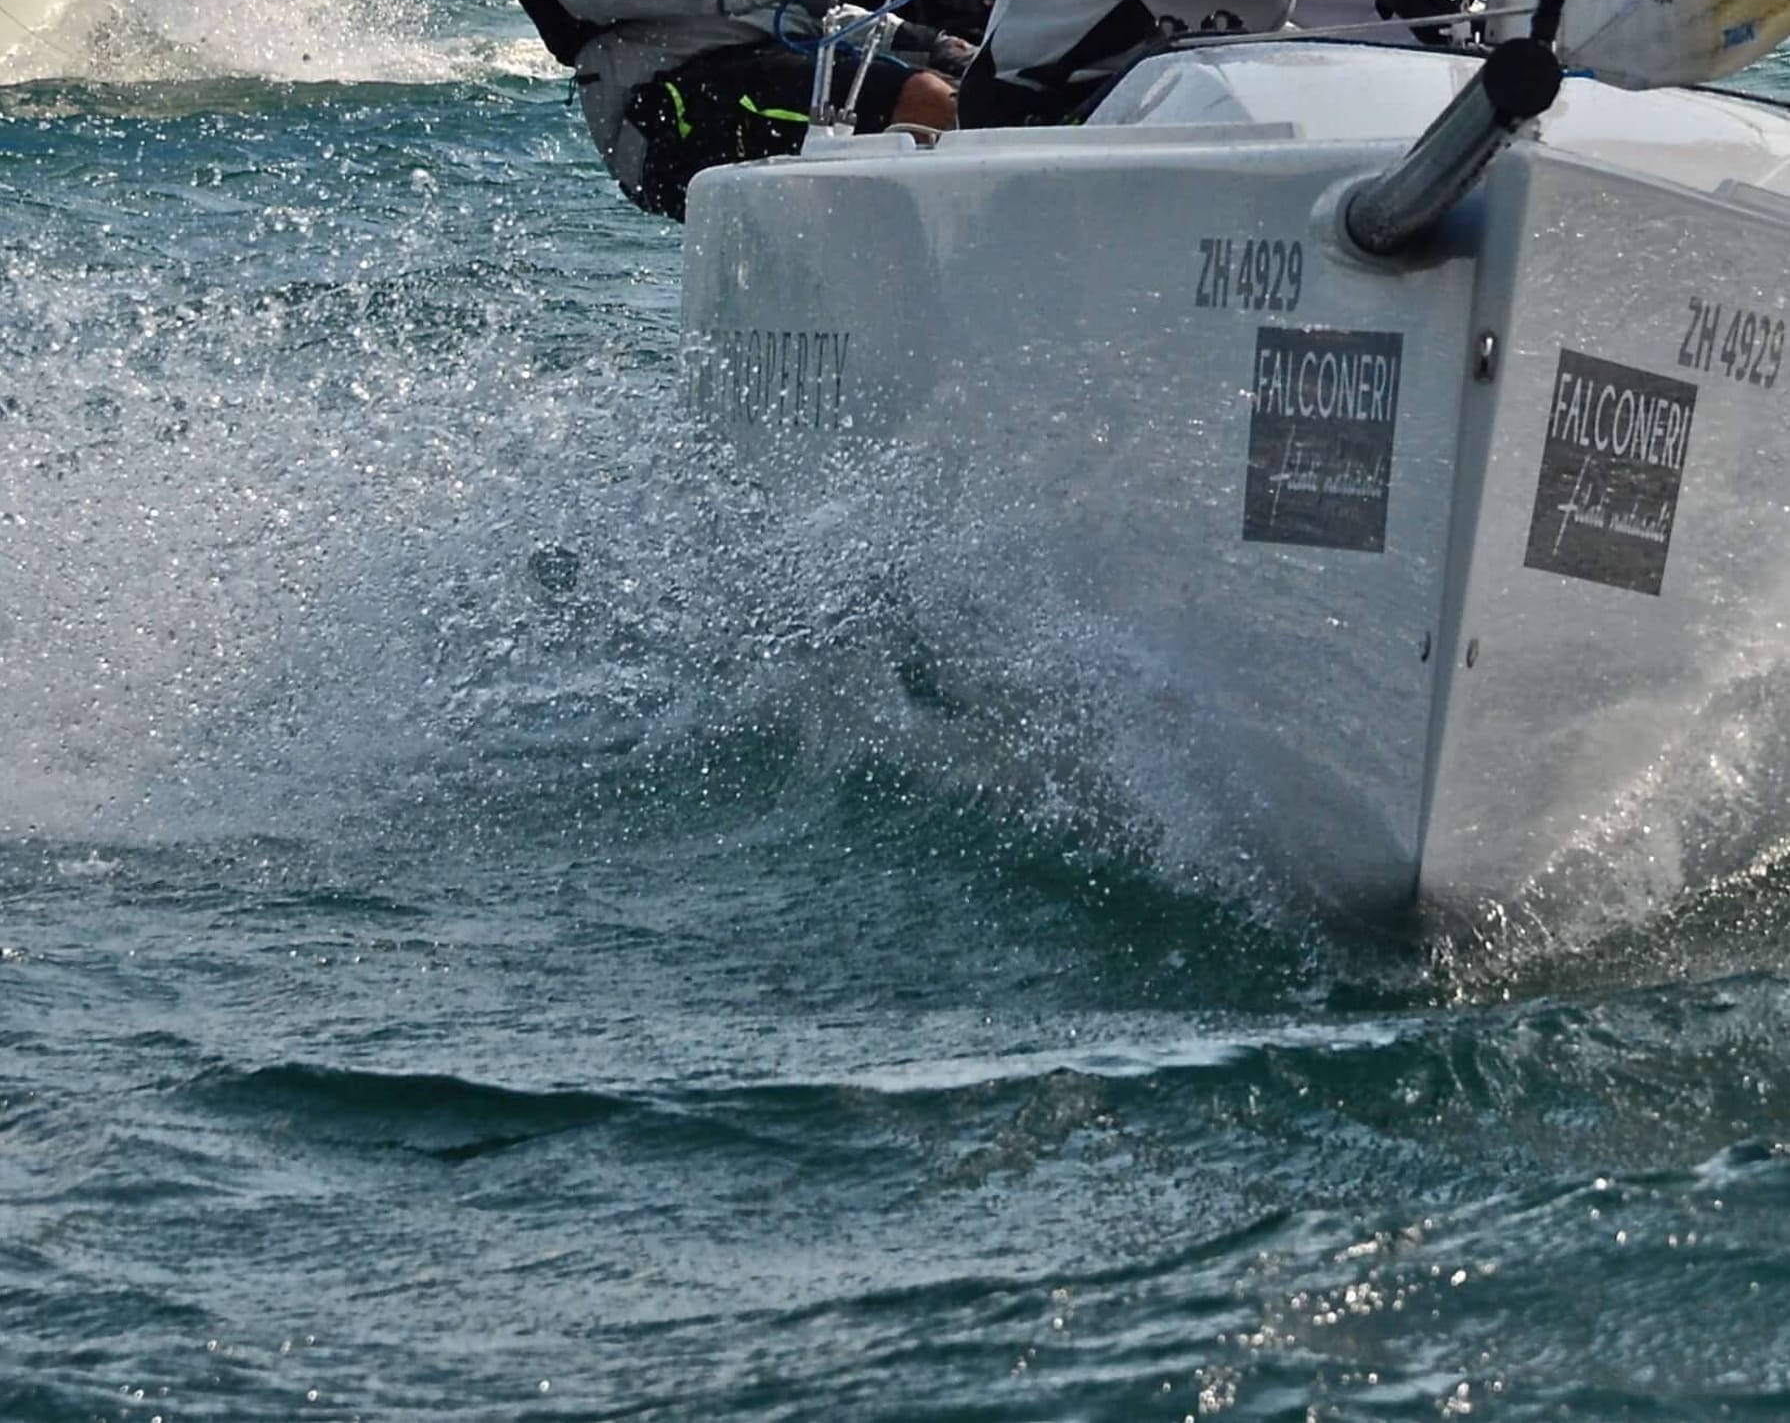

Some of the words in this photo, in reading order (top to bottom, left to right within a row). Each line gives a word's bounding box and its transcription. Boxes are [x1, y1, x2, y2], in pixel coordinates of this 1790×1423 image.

[1195, 238, 1232, 309] ZH
[1236, 238, 1303, 312] 4929
[1678, 296, 1722, 373] ZH
[1720, 308, 1785, 389] 4929
[1254, 348, 1397, 422] FALCONERI
[1551, 372, 1691, 470] FALCONERI
